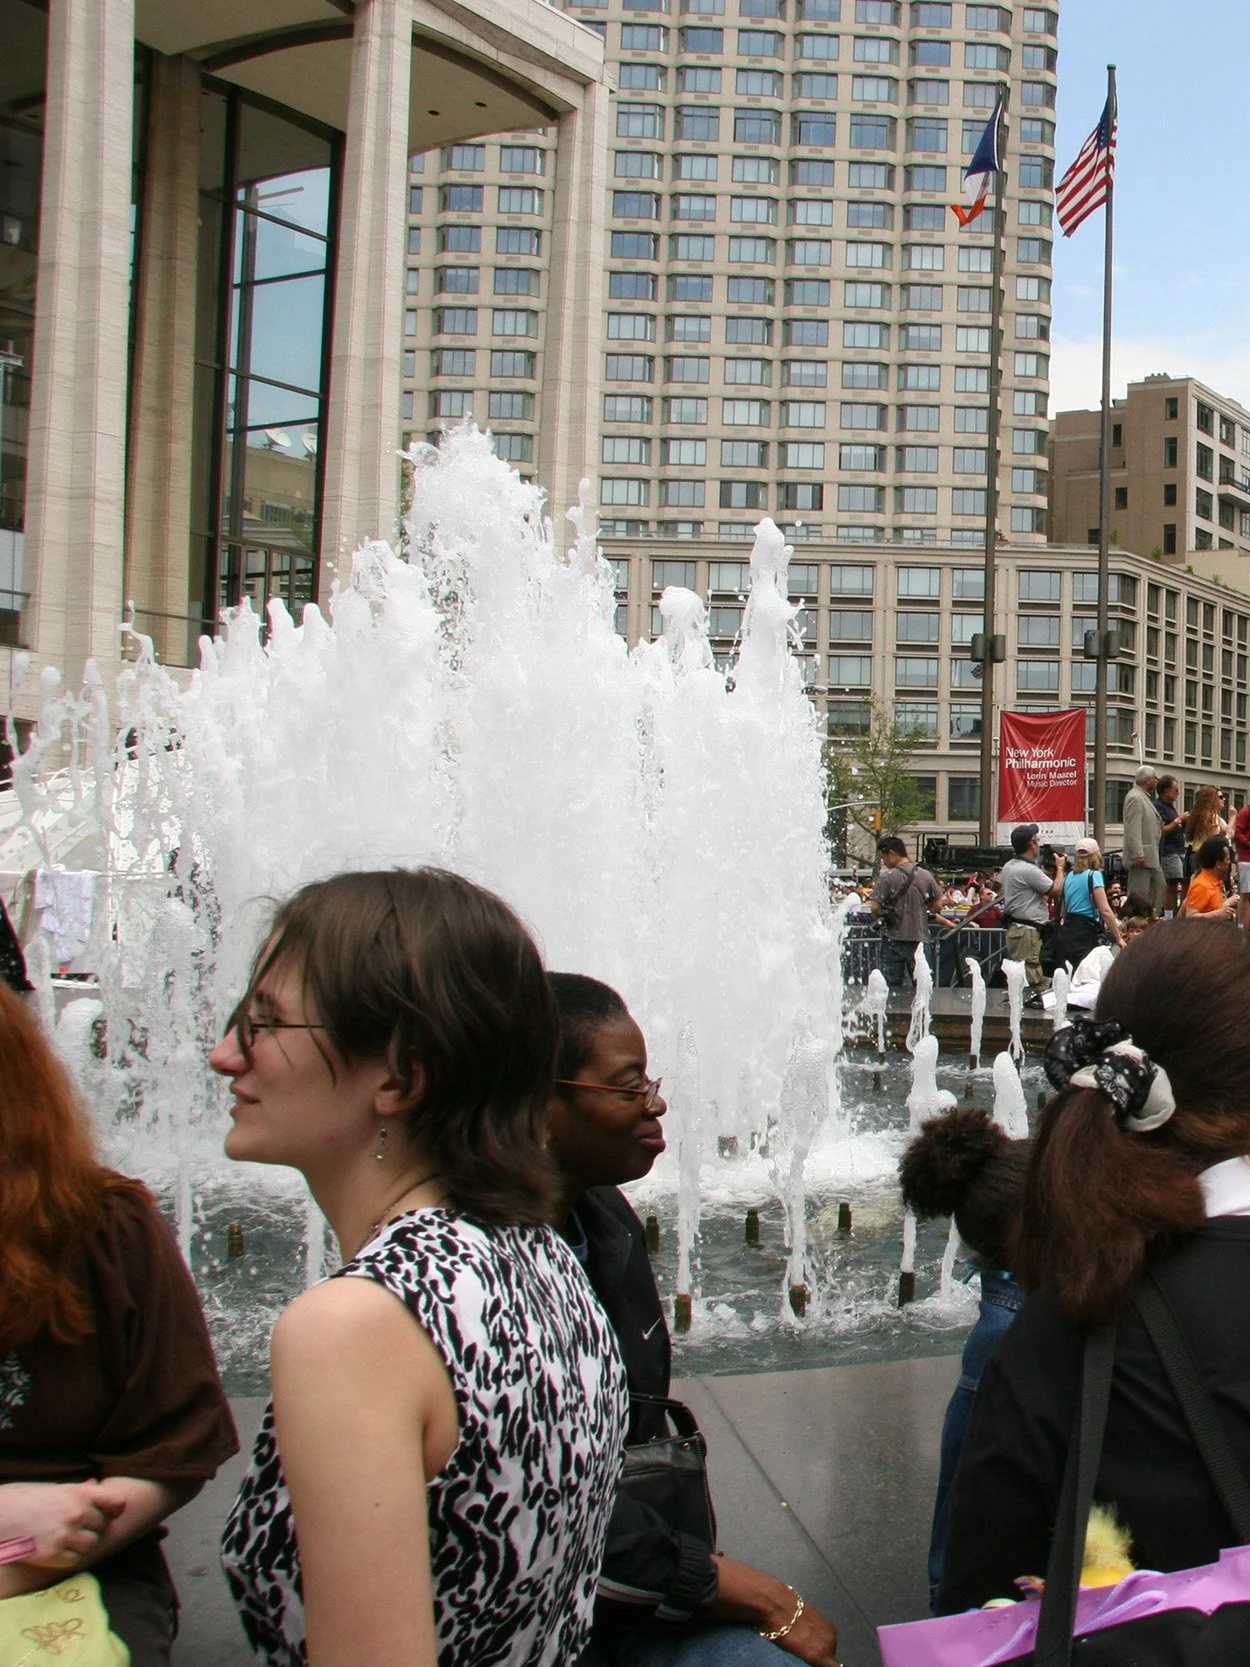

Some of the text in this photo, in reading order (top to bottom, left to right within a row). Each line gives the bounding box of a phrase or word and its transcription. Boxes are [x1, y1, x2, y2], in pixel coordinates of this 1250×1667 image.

[1005, 747, 1054, 758] New York
[1005, 757, 1076, 769] Philharmonic
[1027, 772, 1046, 780] Lorin
[1027, 779, 1077, 788] Music Director
